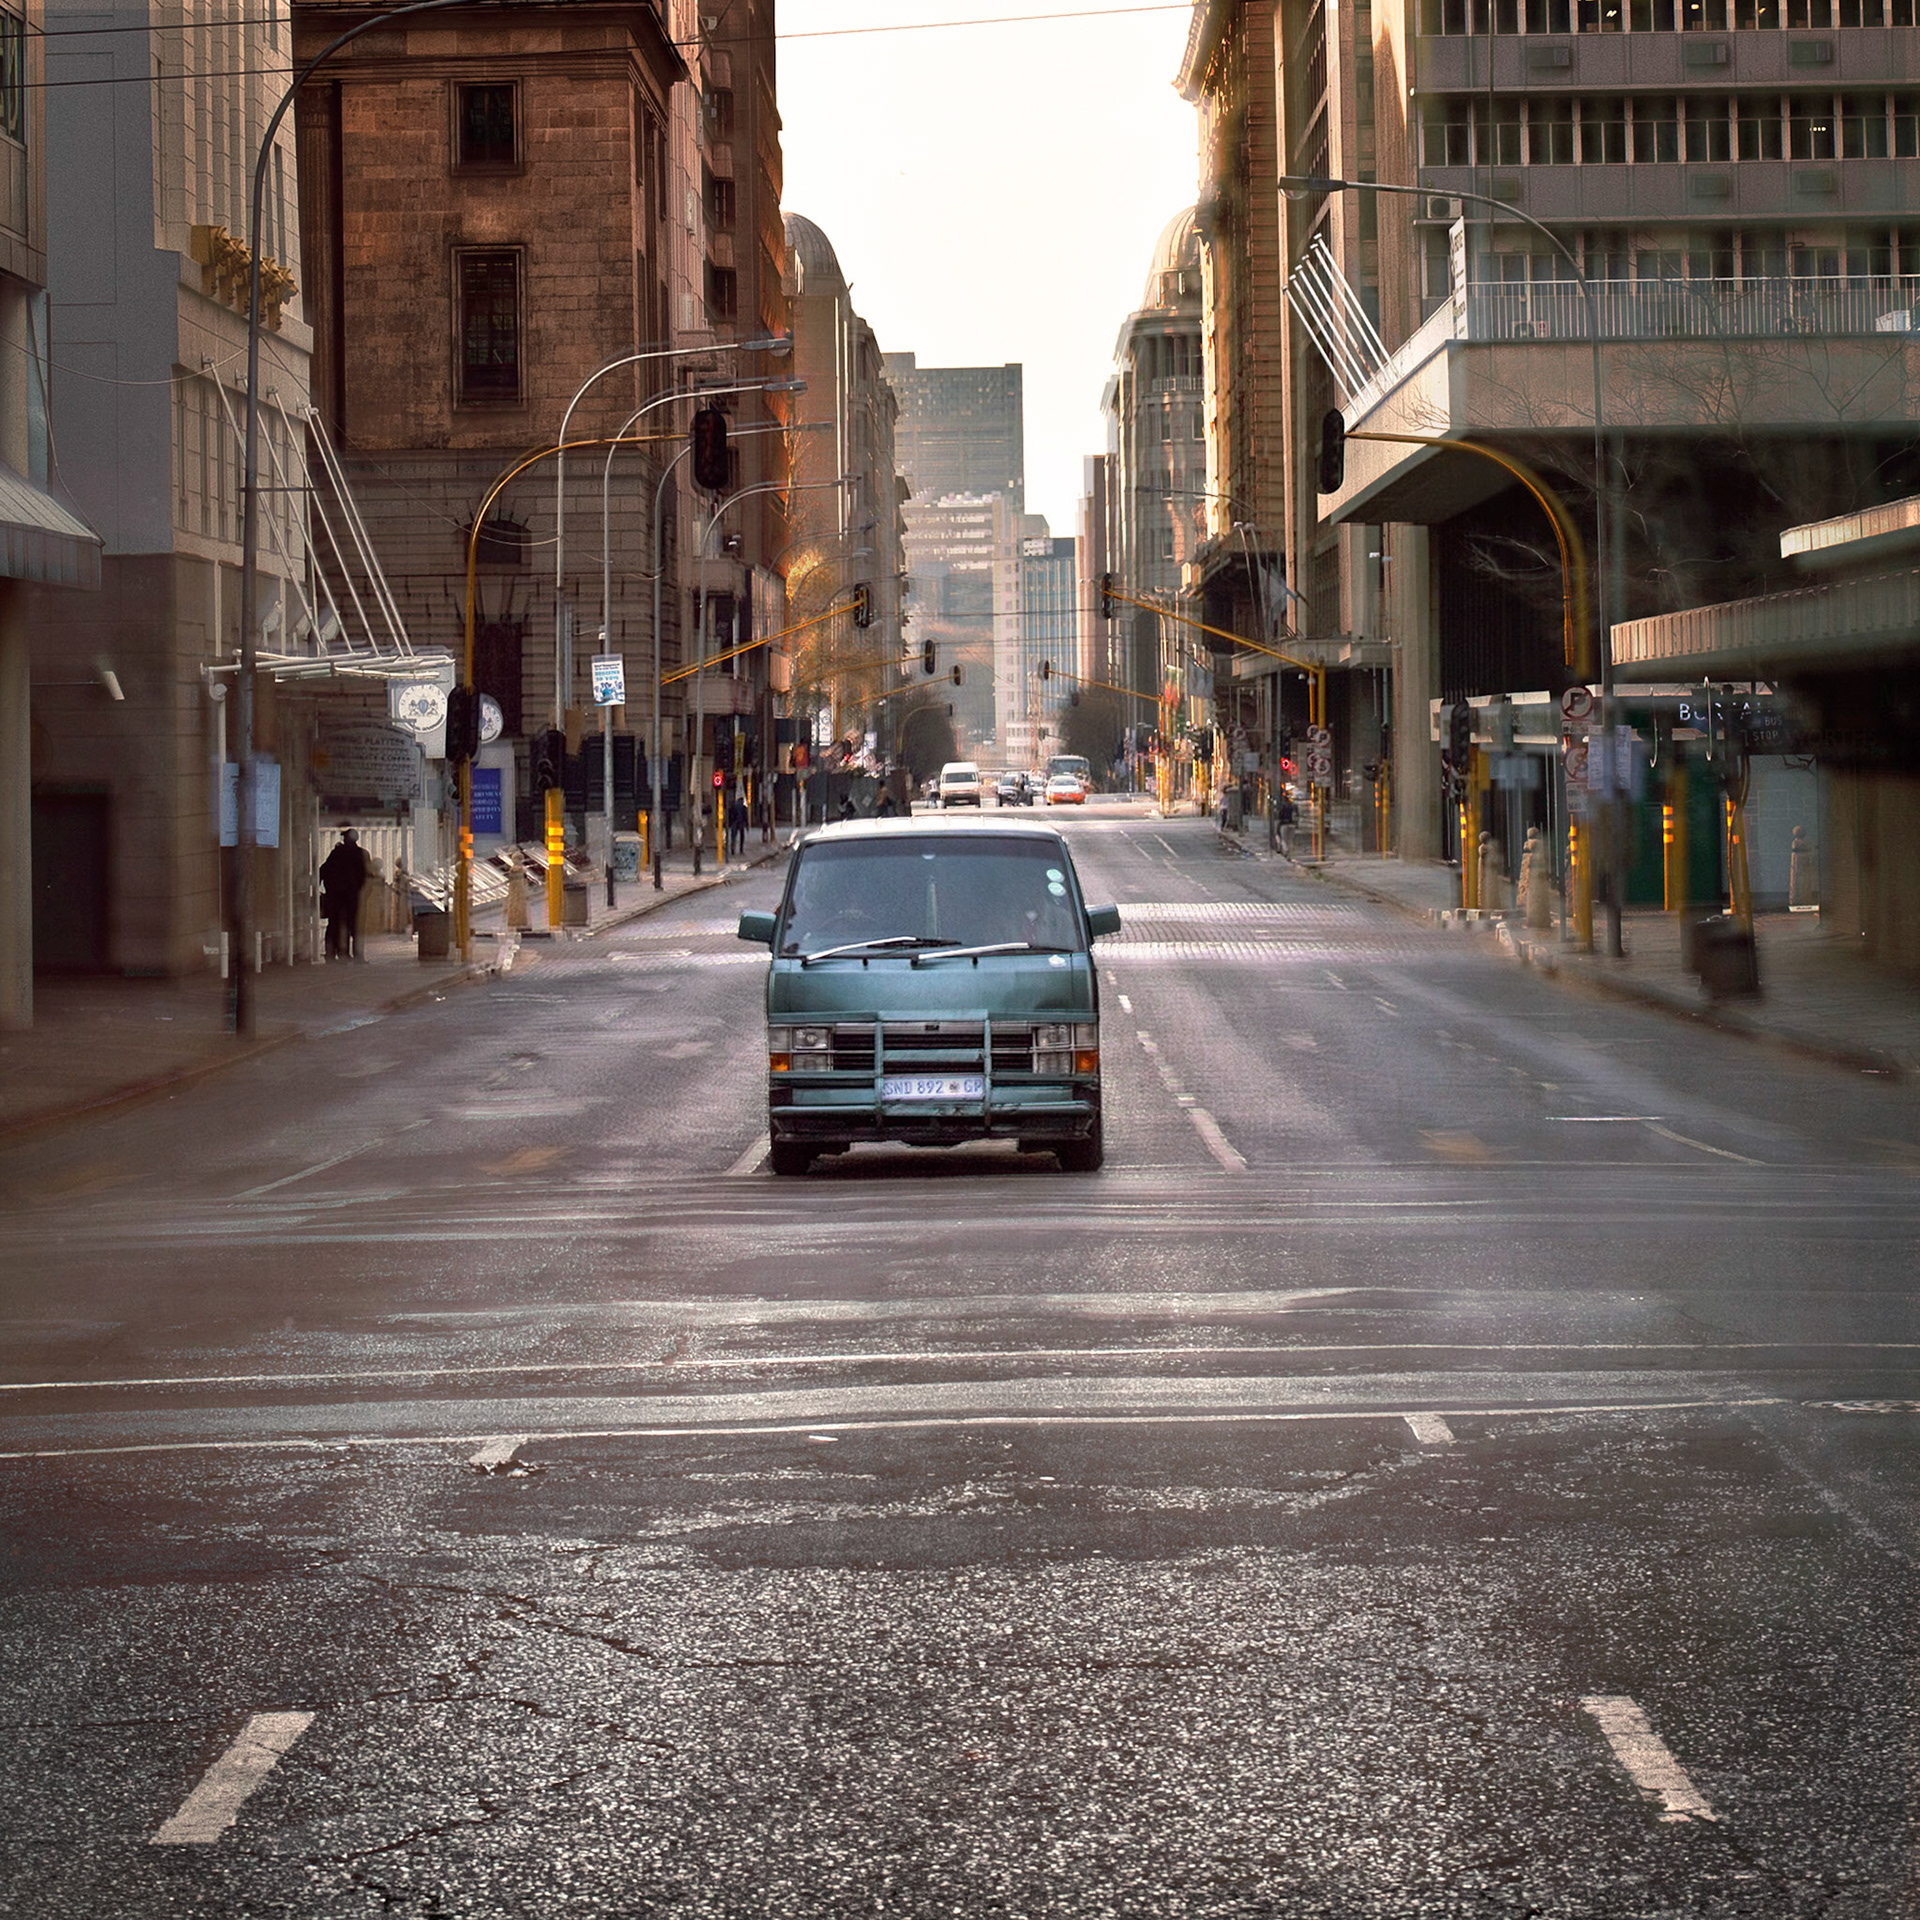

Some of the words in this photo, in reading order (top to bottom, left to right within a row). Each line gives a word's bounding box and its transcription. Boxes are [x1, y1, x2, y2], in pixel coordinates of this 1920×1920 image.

[1764, 716, 1783, 727] BUS
[1754, 730, 1779, 742] STOP
[917, 1080, 944, 1095] 892
[963, 1079, 983, 1094] GP
